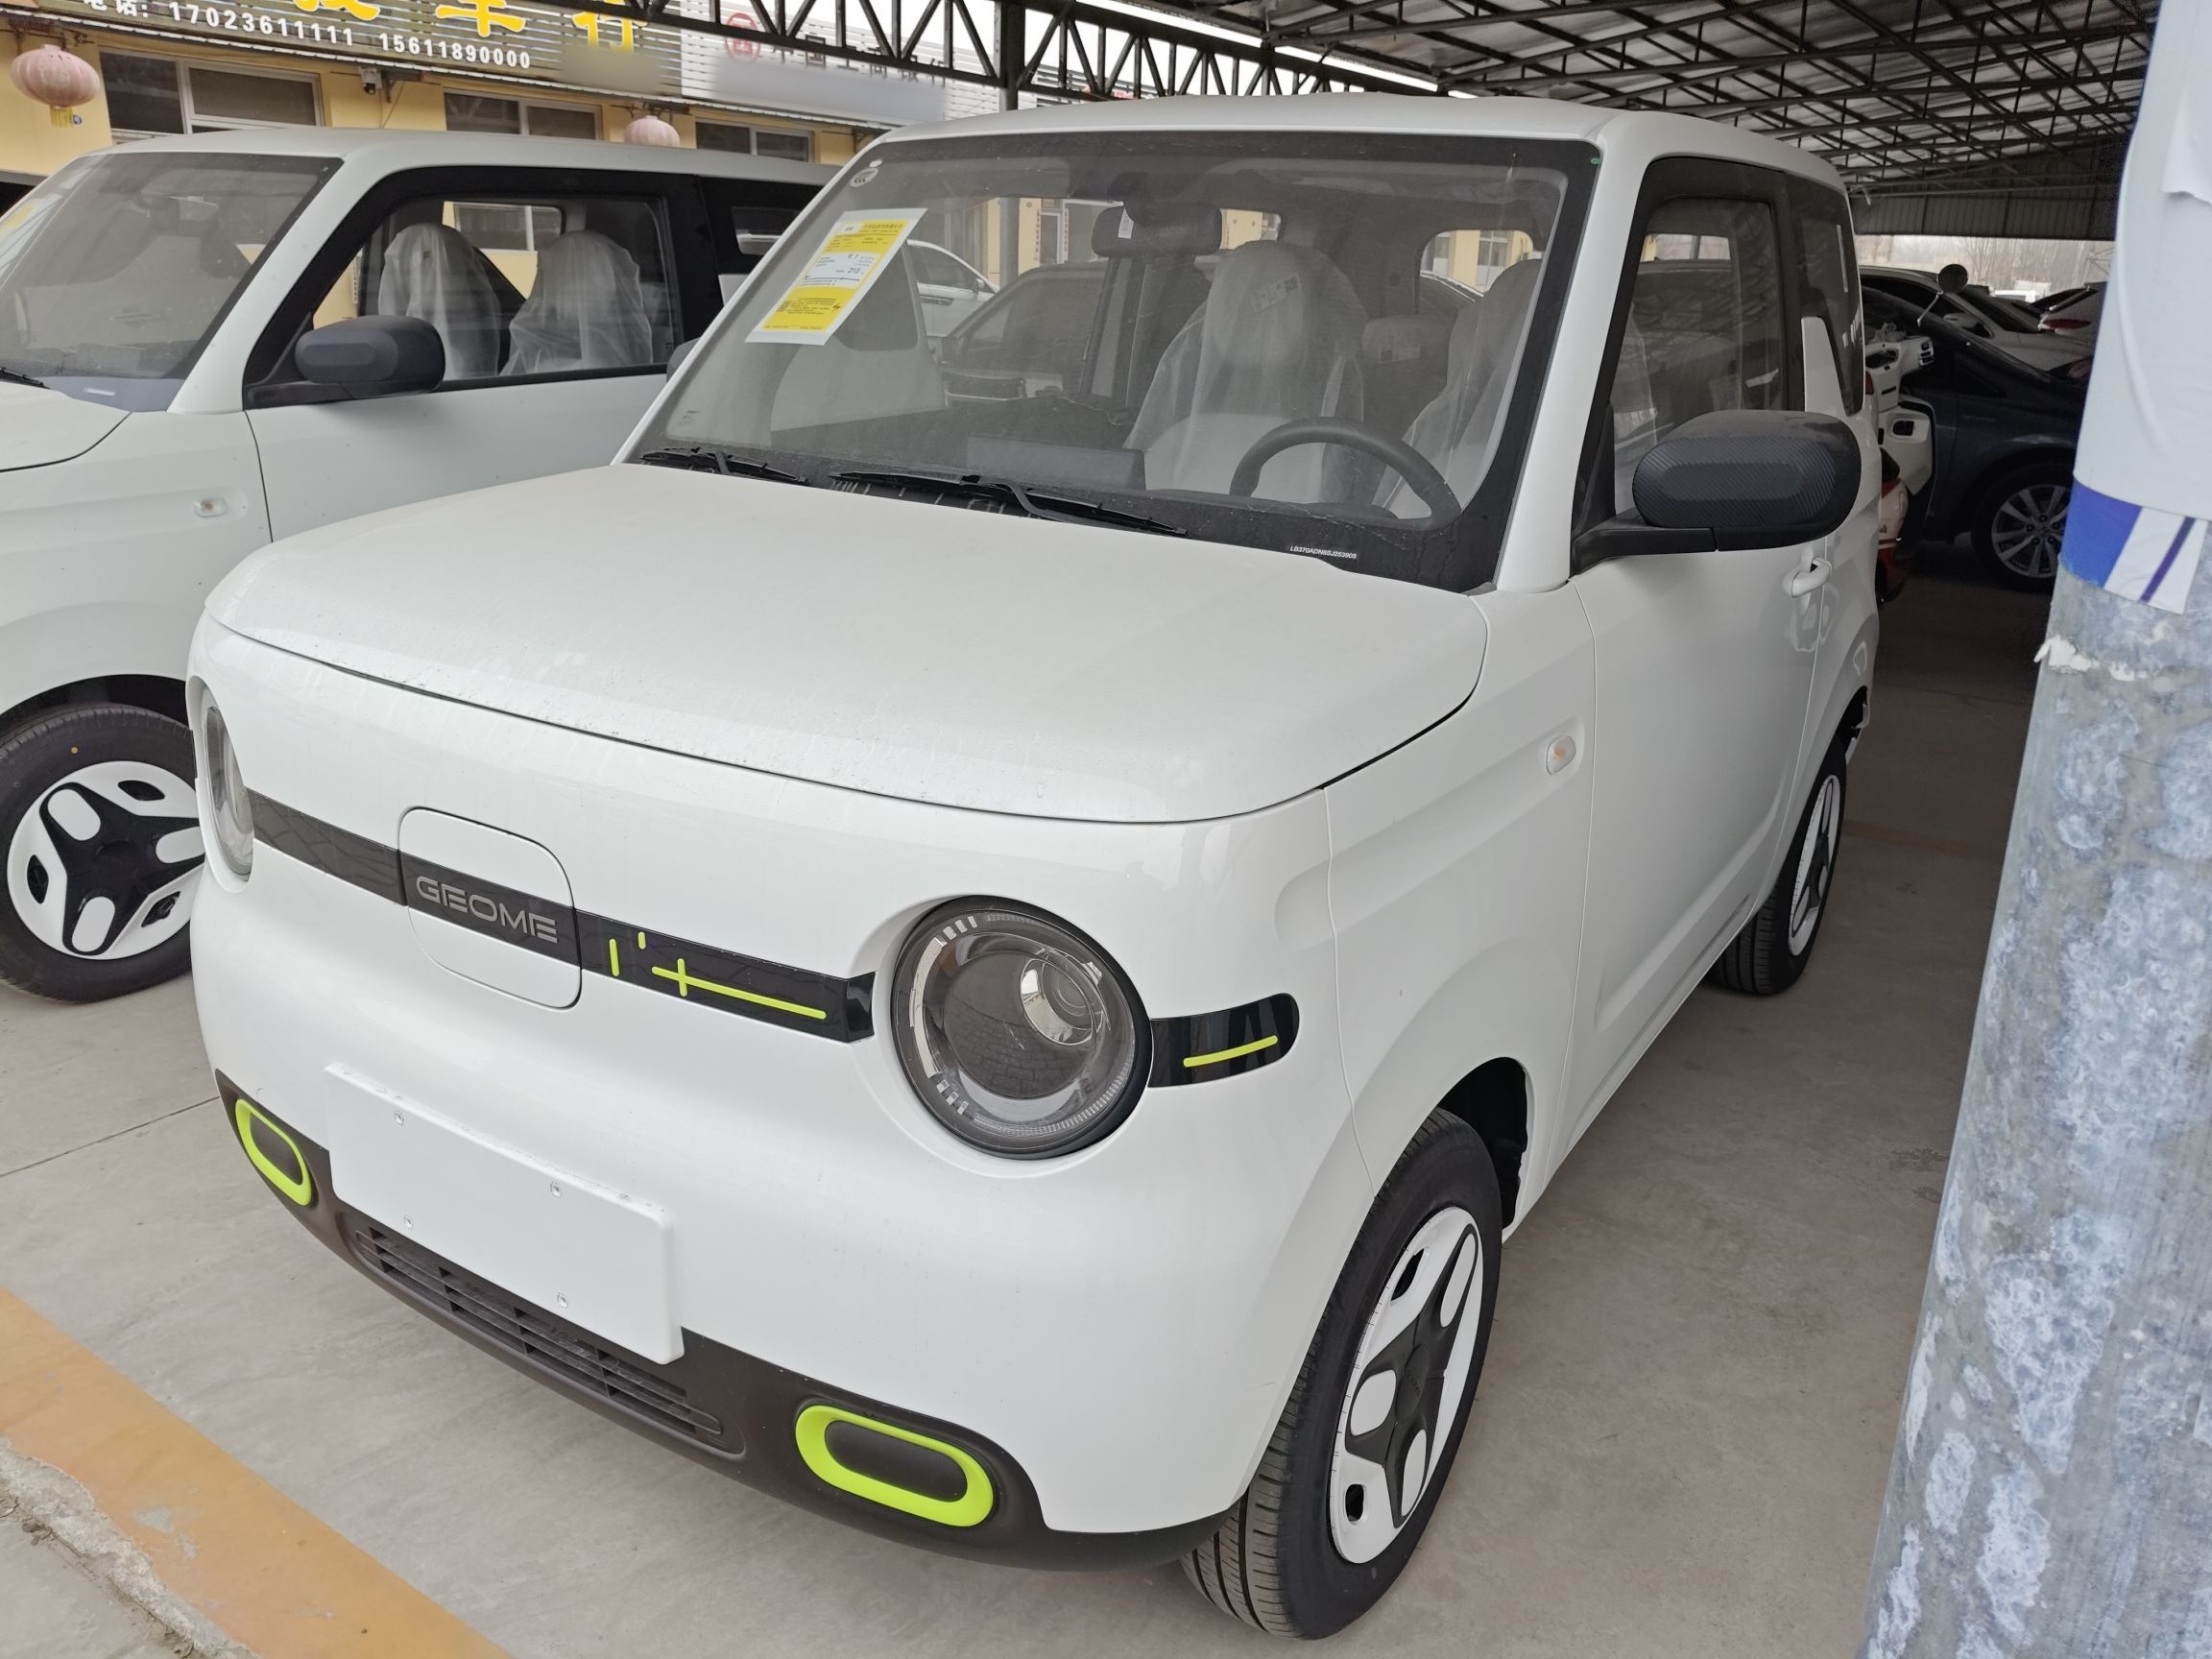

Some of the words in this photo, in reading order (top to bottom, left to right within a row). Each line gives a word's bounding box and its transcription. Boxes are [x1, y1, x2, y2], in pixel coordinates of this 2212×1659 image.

[169, 2, 352, 46] 17023611111
[379, 34, 531, 69] 15611890000
[416, 876, 558, 943] GEOME
